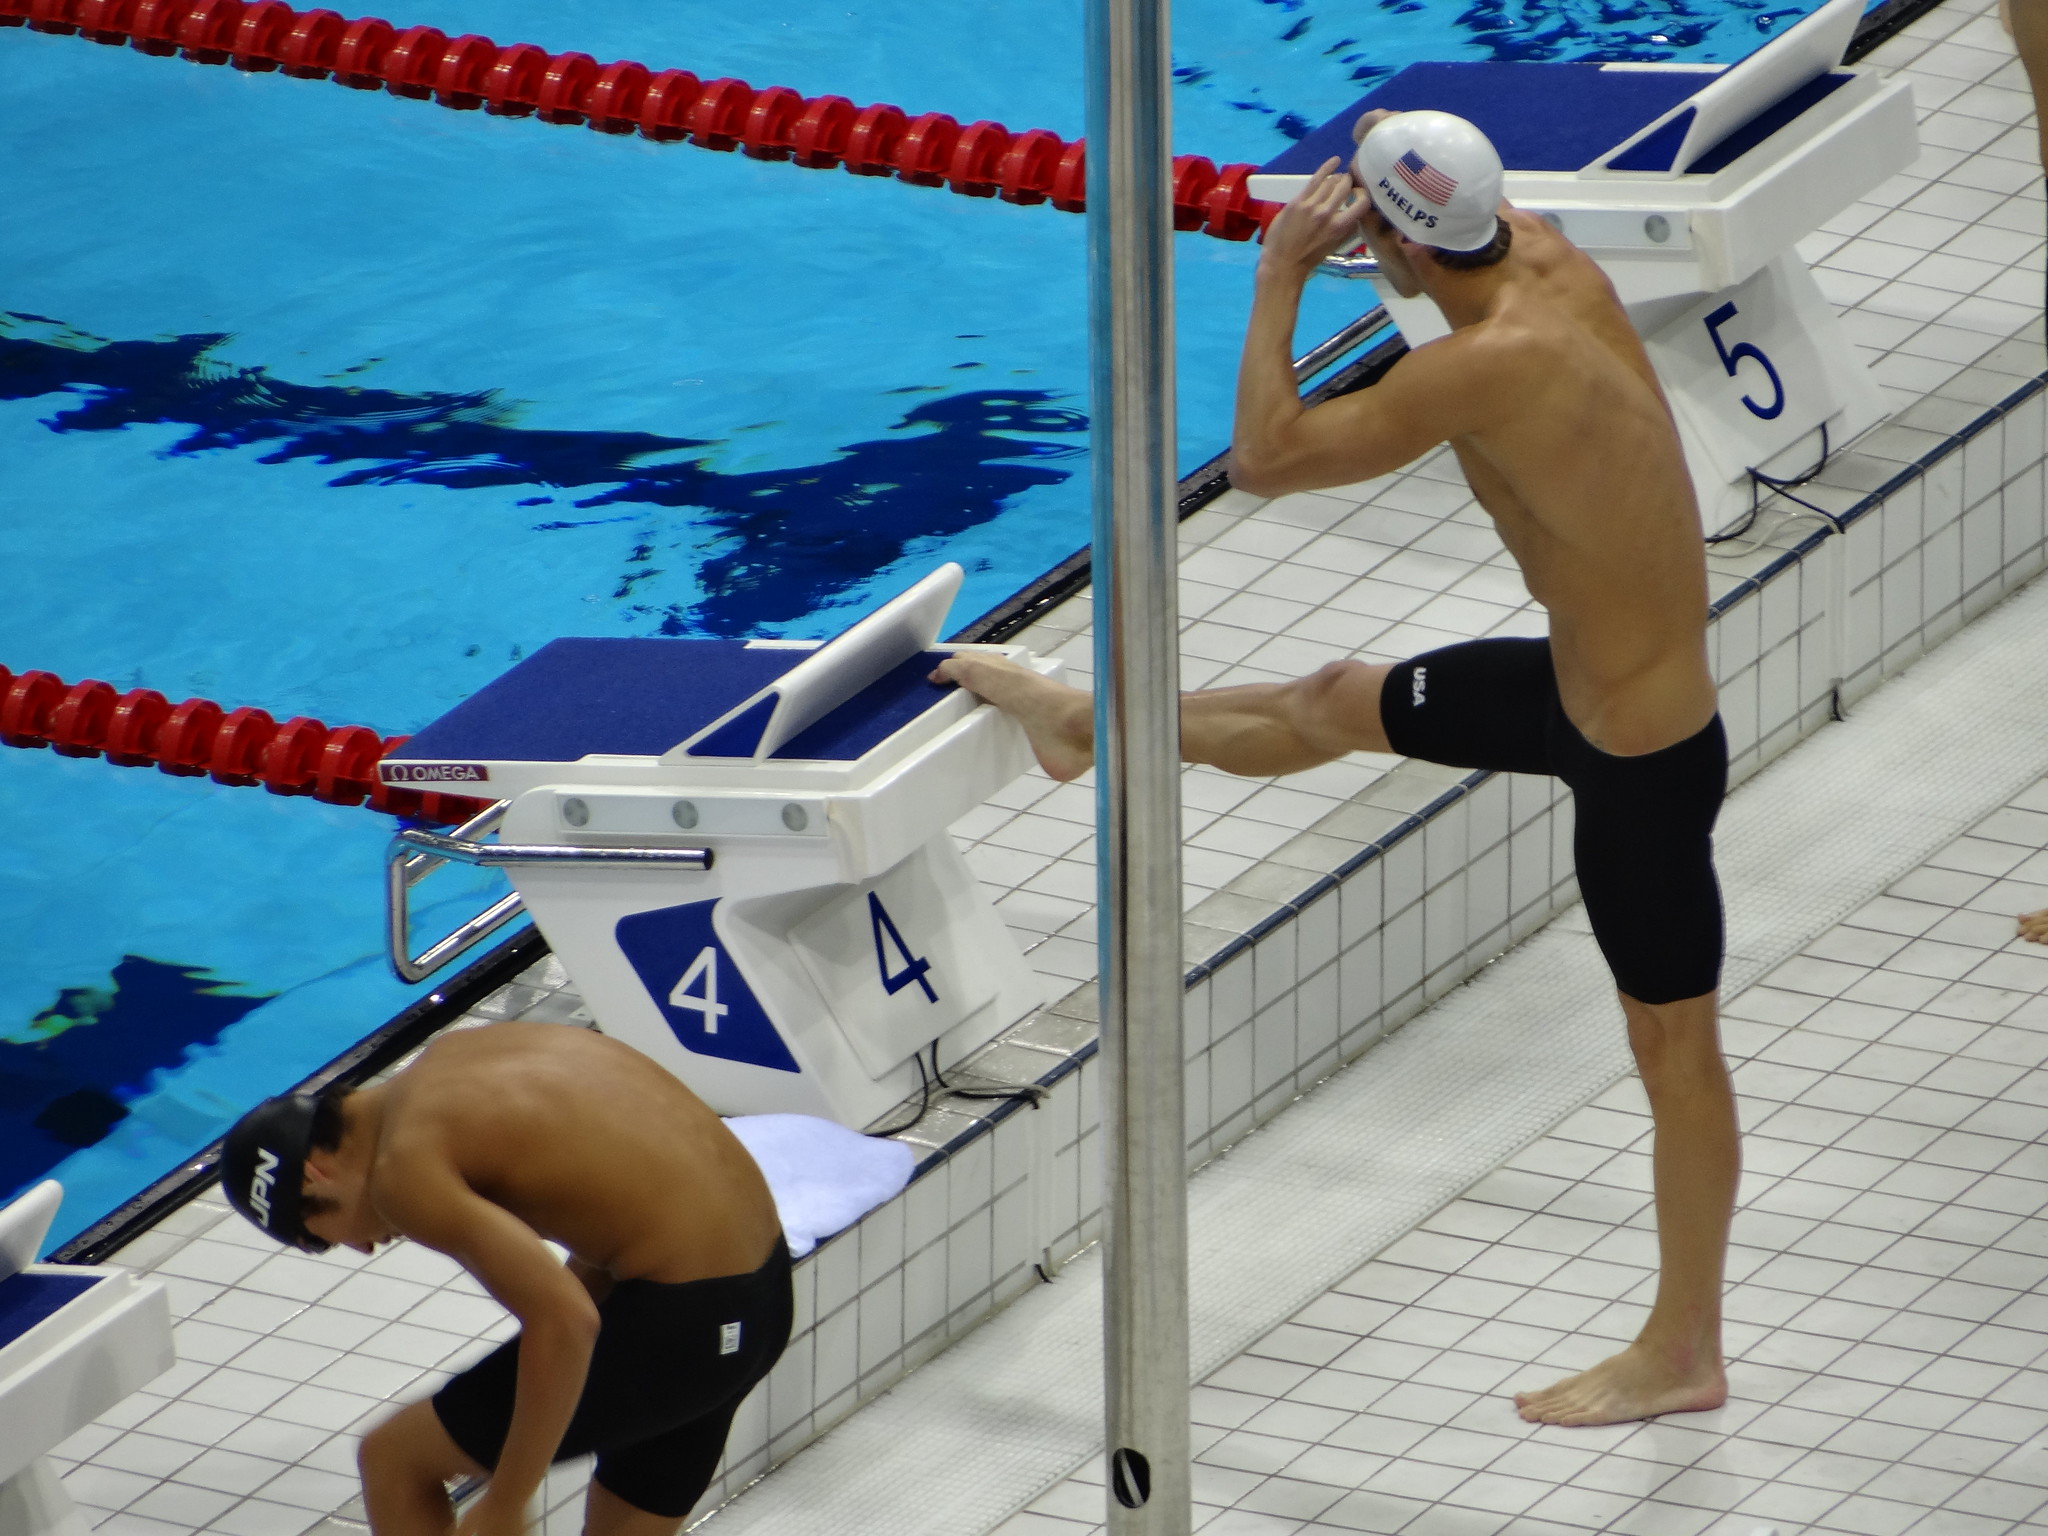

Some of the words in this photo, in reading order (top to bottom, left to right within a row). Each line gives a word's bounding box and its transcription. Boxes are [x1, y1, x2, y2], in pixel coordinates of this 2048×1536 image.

[1378, 177, 1439, 228] PHELPS
[1703, 300, 1785, 421] 5
[1412, 666, 1427, 707] USA
[412, 766, 479, 780] OMEGA
[868, 890, 940, 1004] 4
[668, 945, 729, 1034] 4
[249, 1147, 280, 1228] JPN
